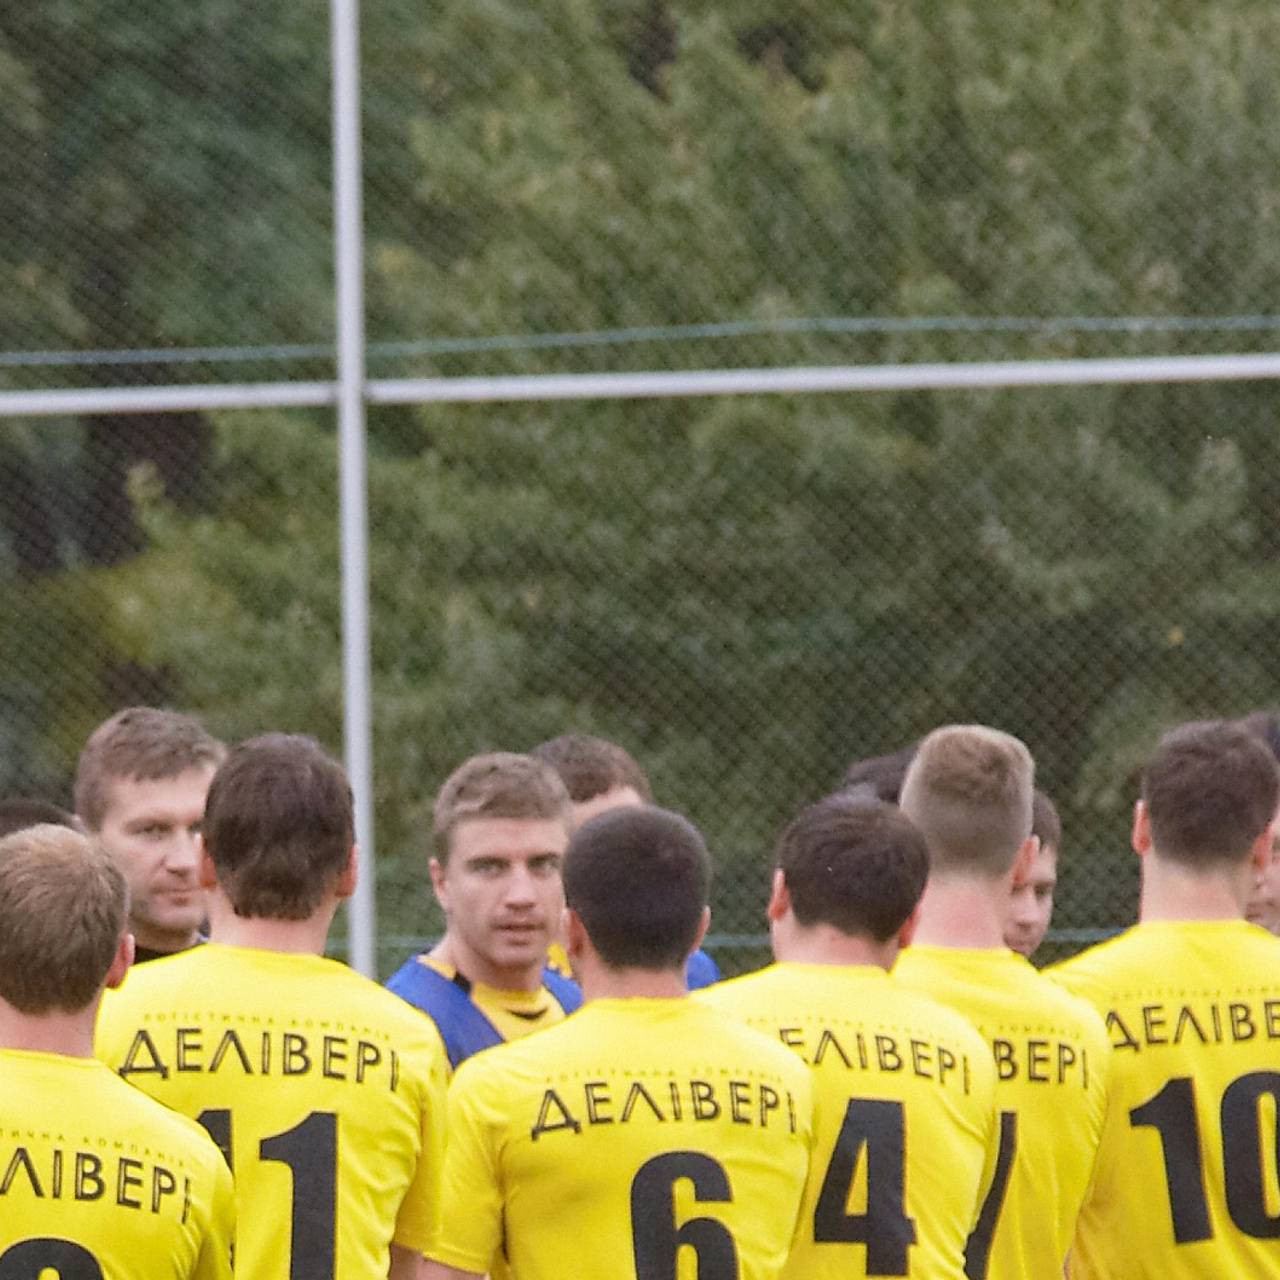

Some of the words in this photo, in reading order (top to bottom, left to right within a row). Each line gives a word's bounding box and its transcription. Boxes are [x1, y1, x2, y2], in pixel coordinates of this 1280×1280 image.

[118, 1028, 400, 1092] ДЕЛІВЕРІ
[531, 1081, 797, 1141] ДЕЛІВЕРІ
[814, 1098, 917, 1276] 4
[1129, 1071, 1280, 1245] 10
